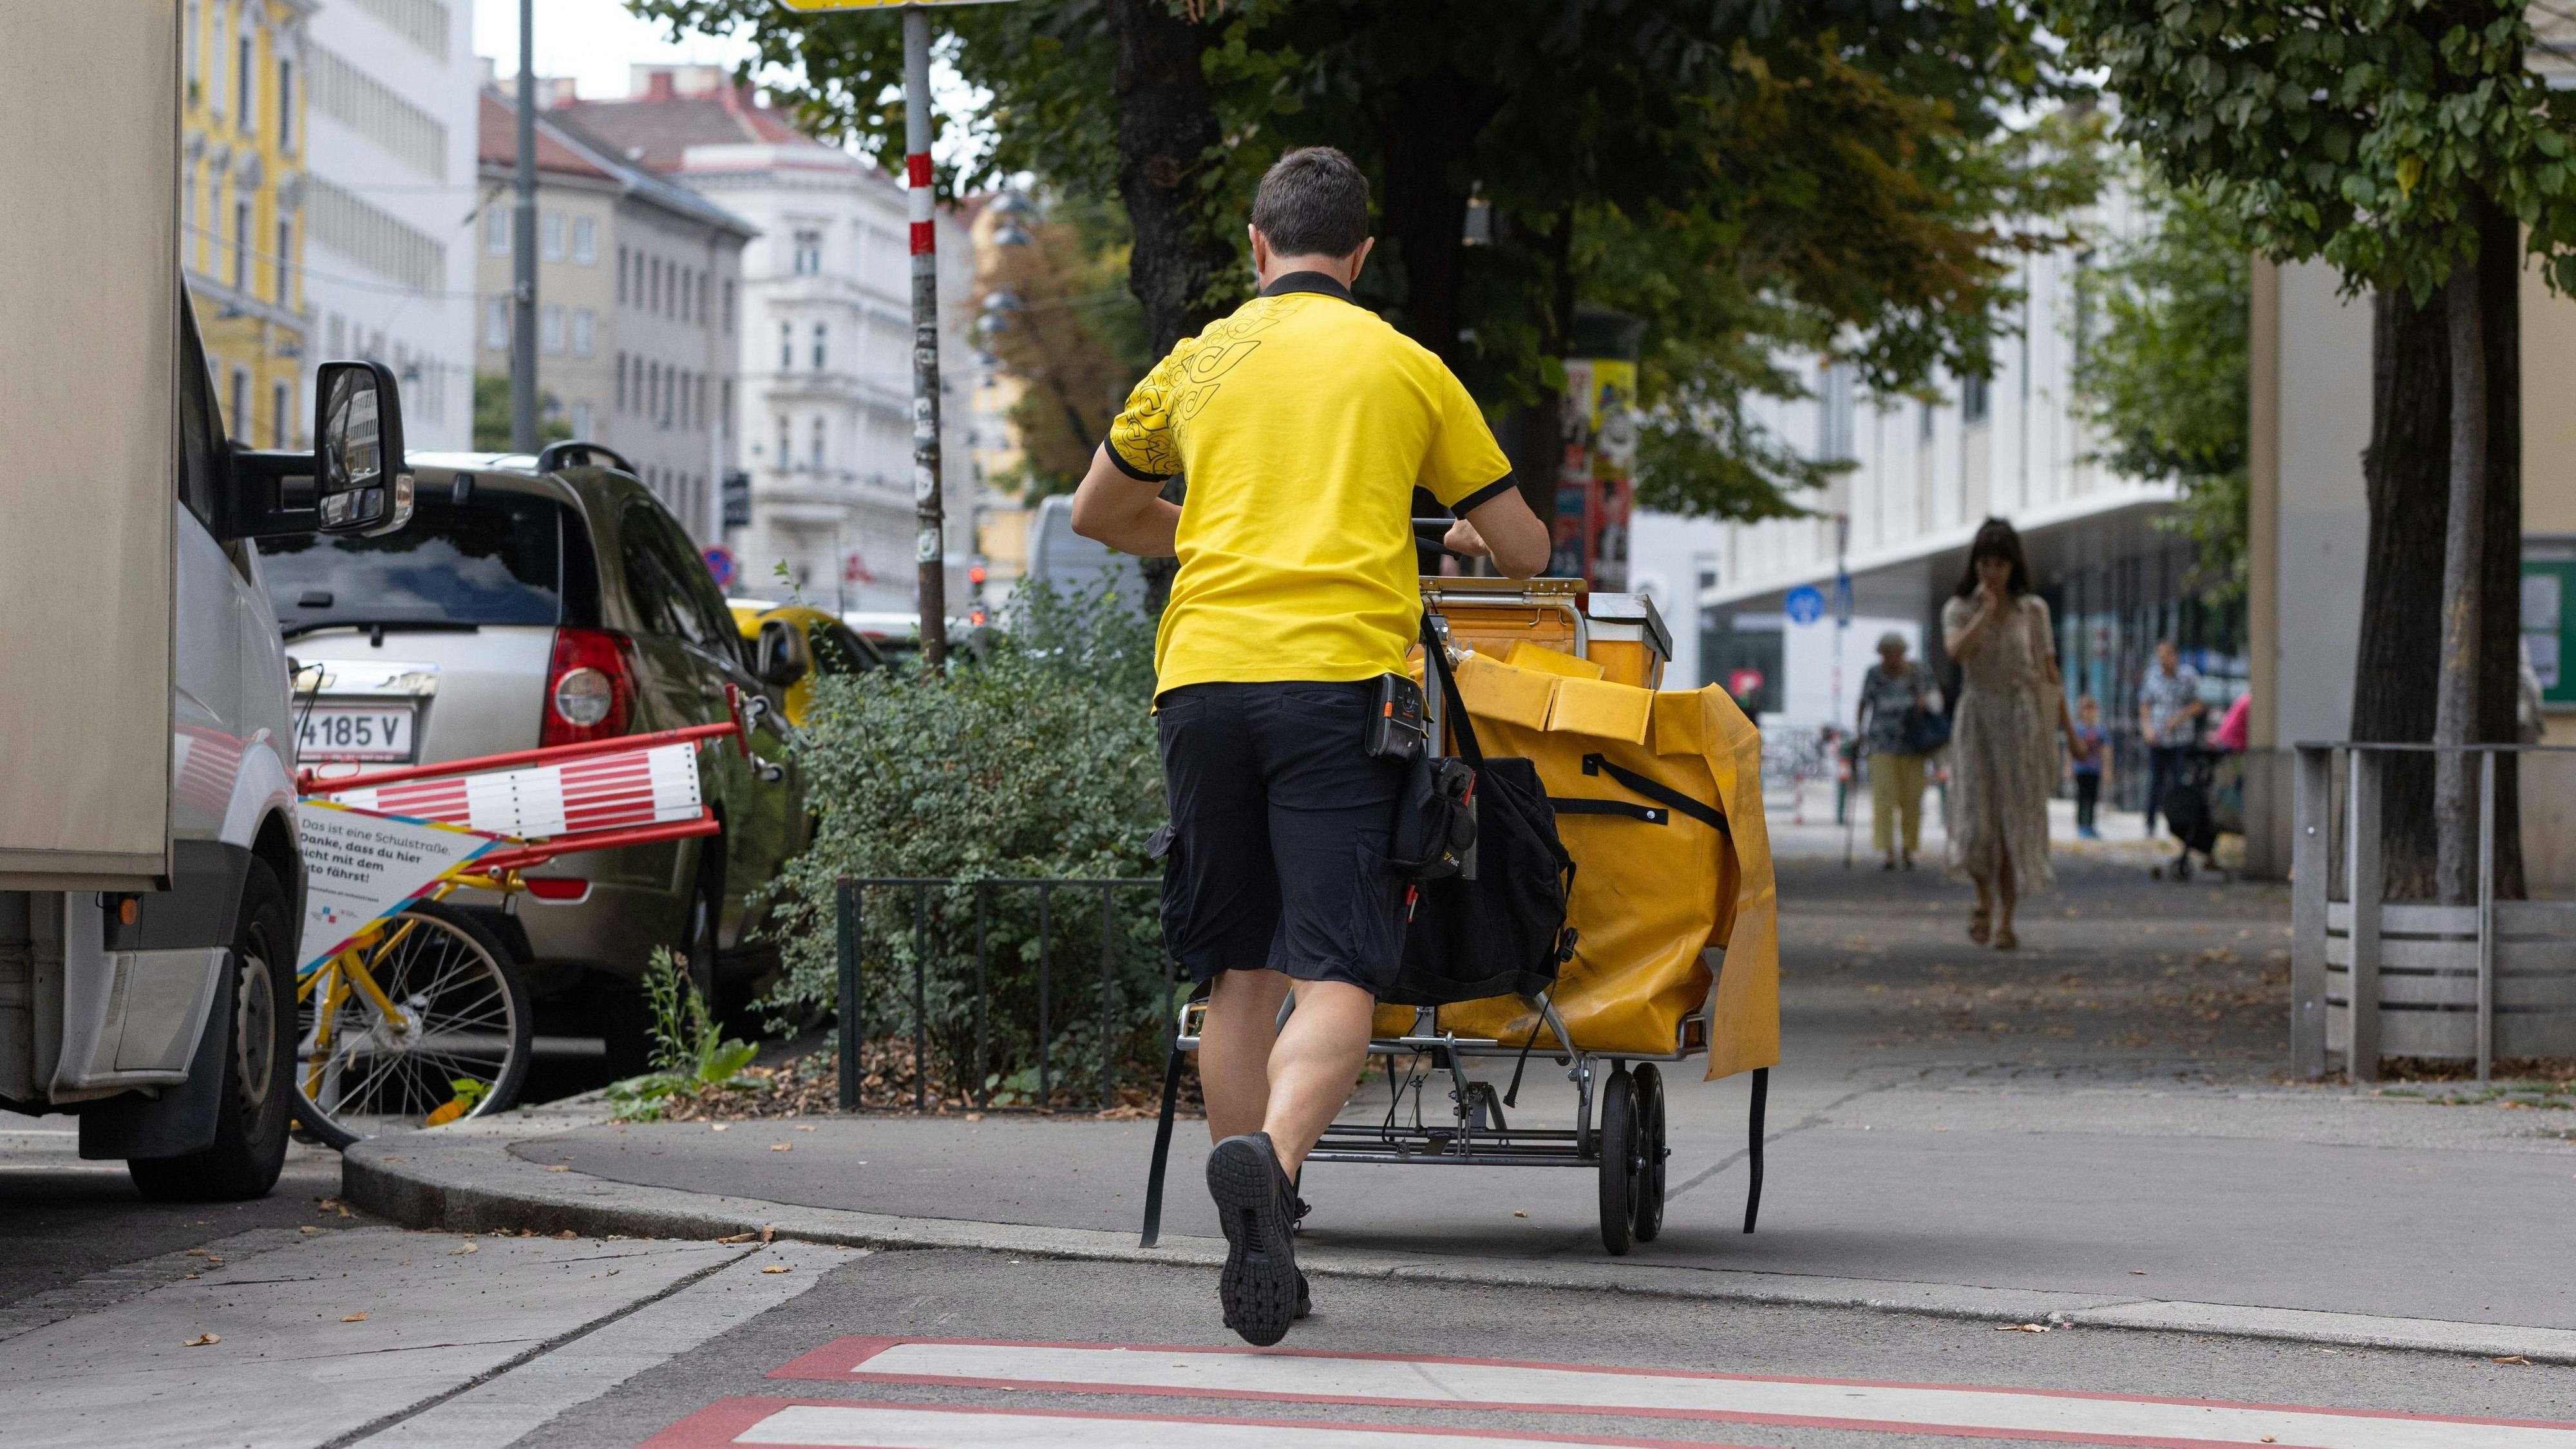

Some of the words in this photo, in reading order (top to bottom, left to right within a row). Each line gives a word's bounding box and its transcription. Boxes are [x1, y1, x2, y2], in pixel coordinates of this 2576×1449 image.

[382, 716, 399, 746] V
[302, 818, 325, 831] Das
[328, 823, 343, 835] ist
[346, 828, 373, 840] eine
[300, 832, 342, 851] Danke,
[346, 841, 374, 855] dass
[377, 847, 393, 858] du
[397, 850, 422, 863] hier
[303, 846, 329, 860] icht
[332, 855, 354, 866] mit
[357, 858, 384, 871] dem
[1448, 857, 1459, 866] Post
[327, 866, 370, 883] fährst!
